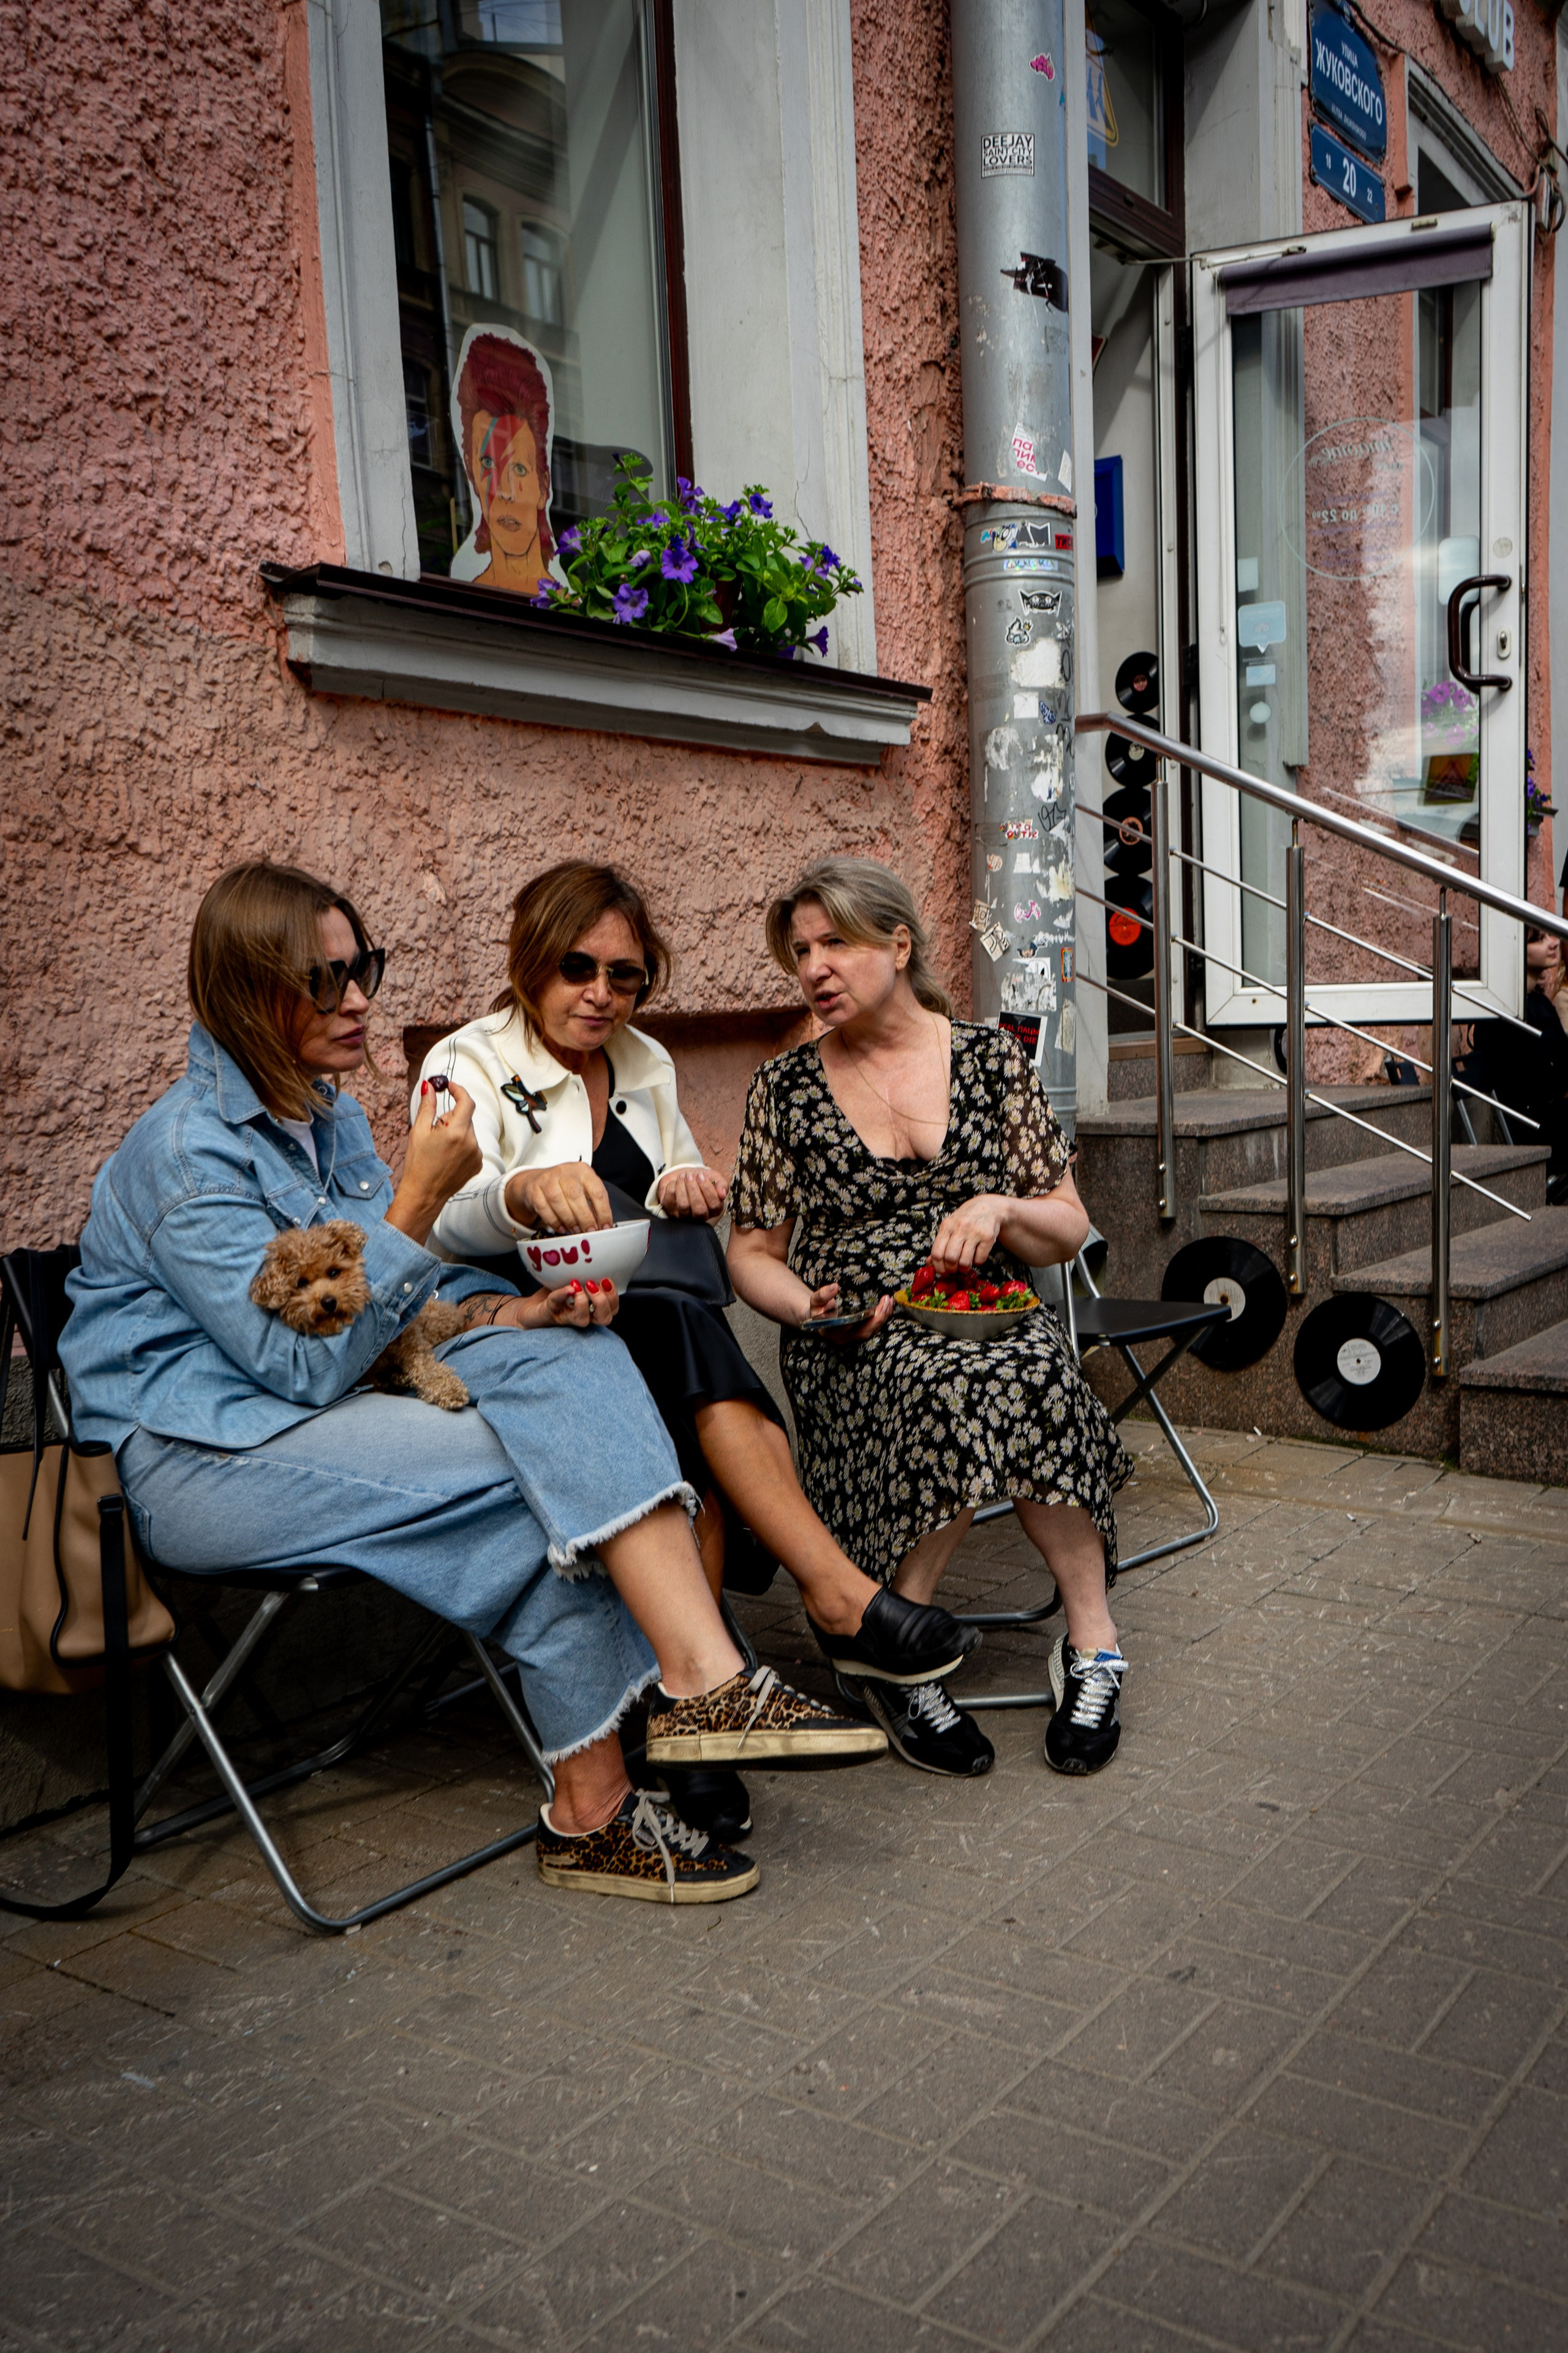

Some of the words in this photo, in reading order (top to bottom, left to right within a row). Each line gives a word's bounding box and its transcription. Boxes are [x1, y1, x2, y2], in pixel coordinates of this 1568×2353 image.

[1341, 40, 1359, 68] УЛИЦА
[1315, 37, 1383, 126] ЖУКОВСКОГО
[984, 134, 1032, 149] DEEJAY
[984, 147, 1008, 157] SAINT
[1012, 146, 1032, 156] CITY
[984, 154, 1032, 166] LOVERS
[1342, 157, 1356, 198] 20
[1023, 1035, 1037, 1045] DIE
